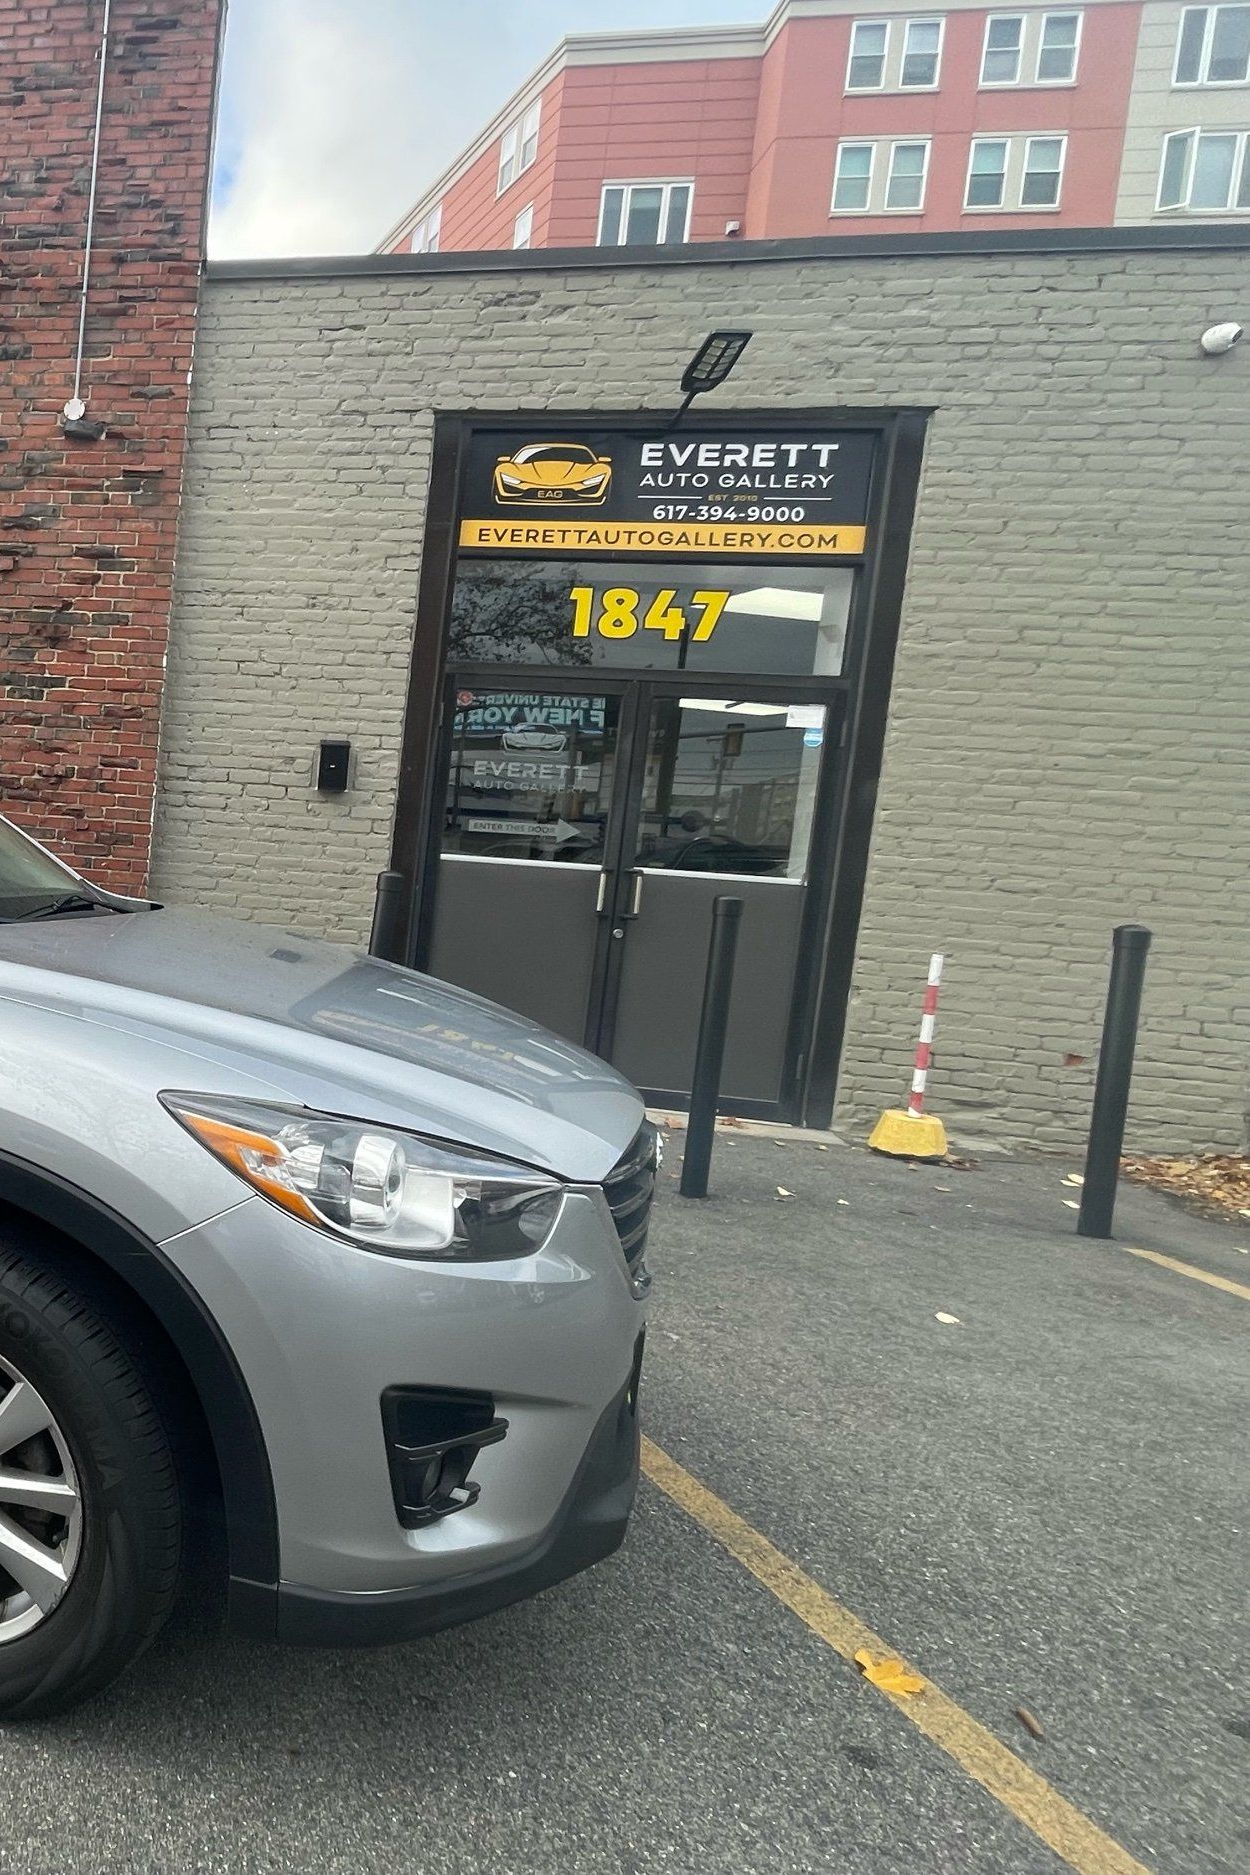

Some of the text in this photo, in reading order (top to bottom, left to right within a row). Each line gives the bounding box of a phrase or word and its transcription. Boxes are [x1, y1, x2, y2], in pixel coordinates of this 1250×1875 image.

[640, 442, 840, 469] EVERETT
[638, 473, 836, 490] AUTO GALLERY
[537, 490, 563, 500] EAG
[732, 494, 758, 503] 2010
[653, 505, 805, 523] 617-394-9000
[477, 528, 839, 549] EVERETTAUTOGALLERY.COM
[569, 586, 731, 643] 1847
[473, 760, 589, 781] EVERETT
[474, 780, 513, 791] AUTO
[473, 821, 503, 831] ENTER
